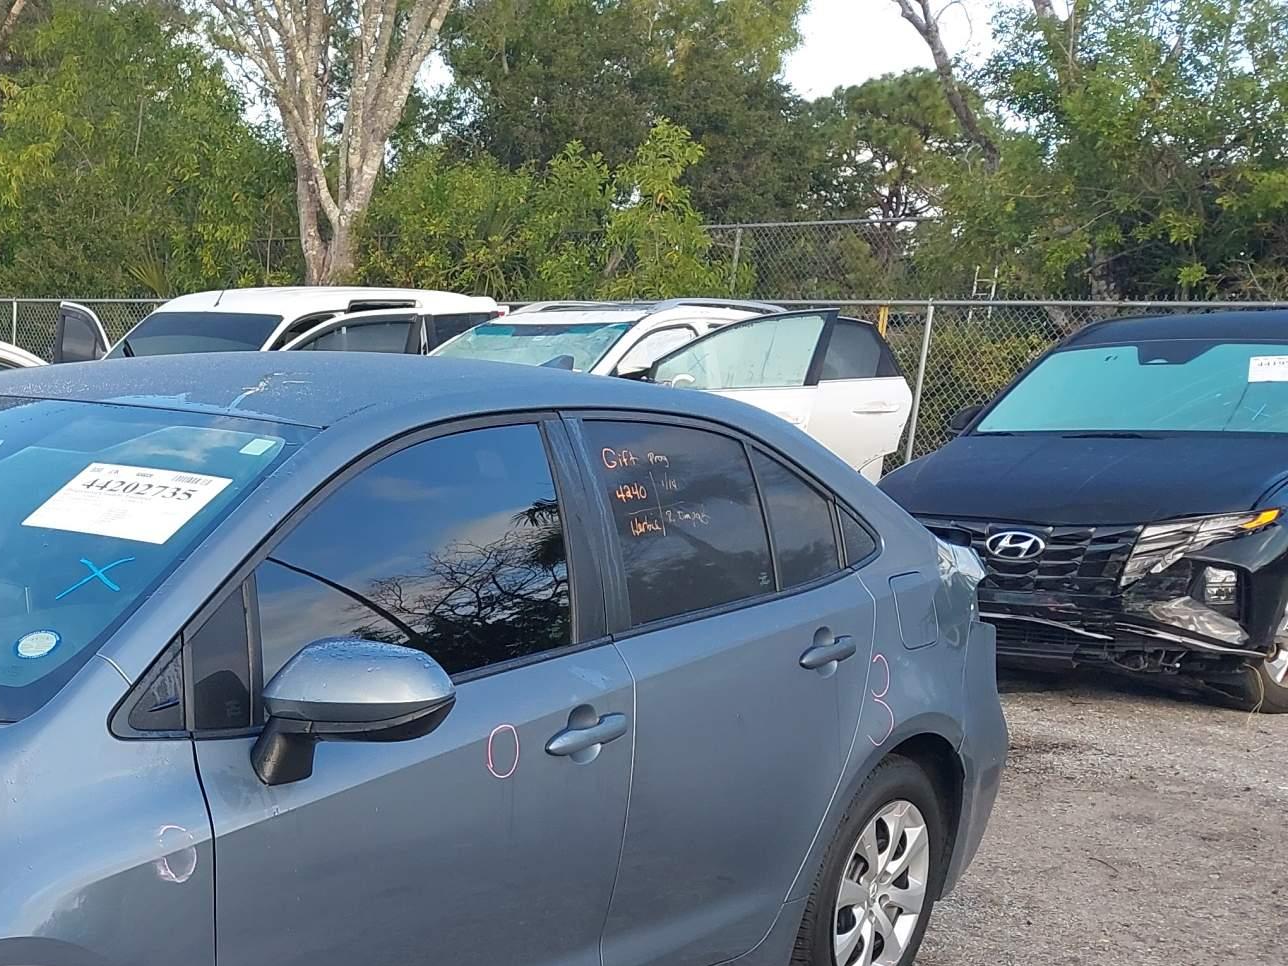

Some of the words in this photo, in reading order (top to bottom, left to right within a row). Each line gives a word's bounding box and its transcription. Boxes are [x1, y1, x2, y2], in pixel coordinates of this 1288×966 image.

[602, 447, 639, 469] Gift
[81, 478, 200, 501] 44202735
[616, 482, 648, 503] 4240
